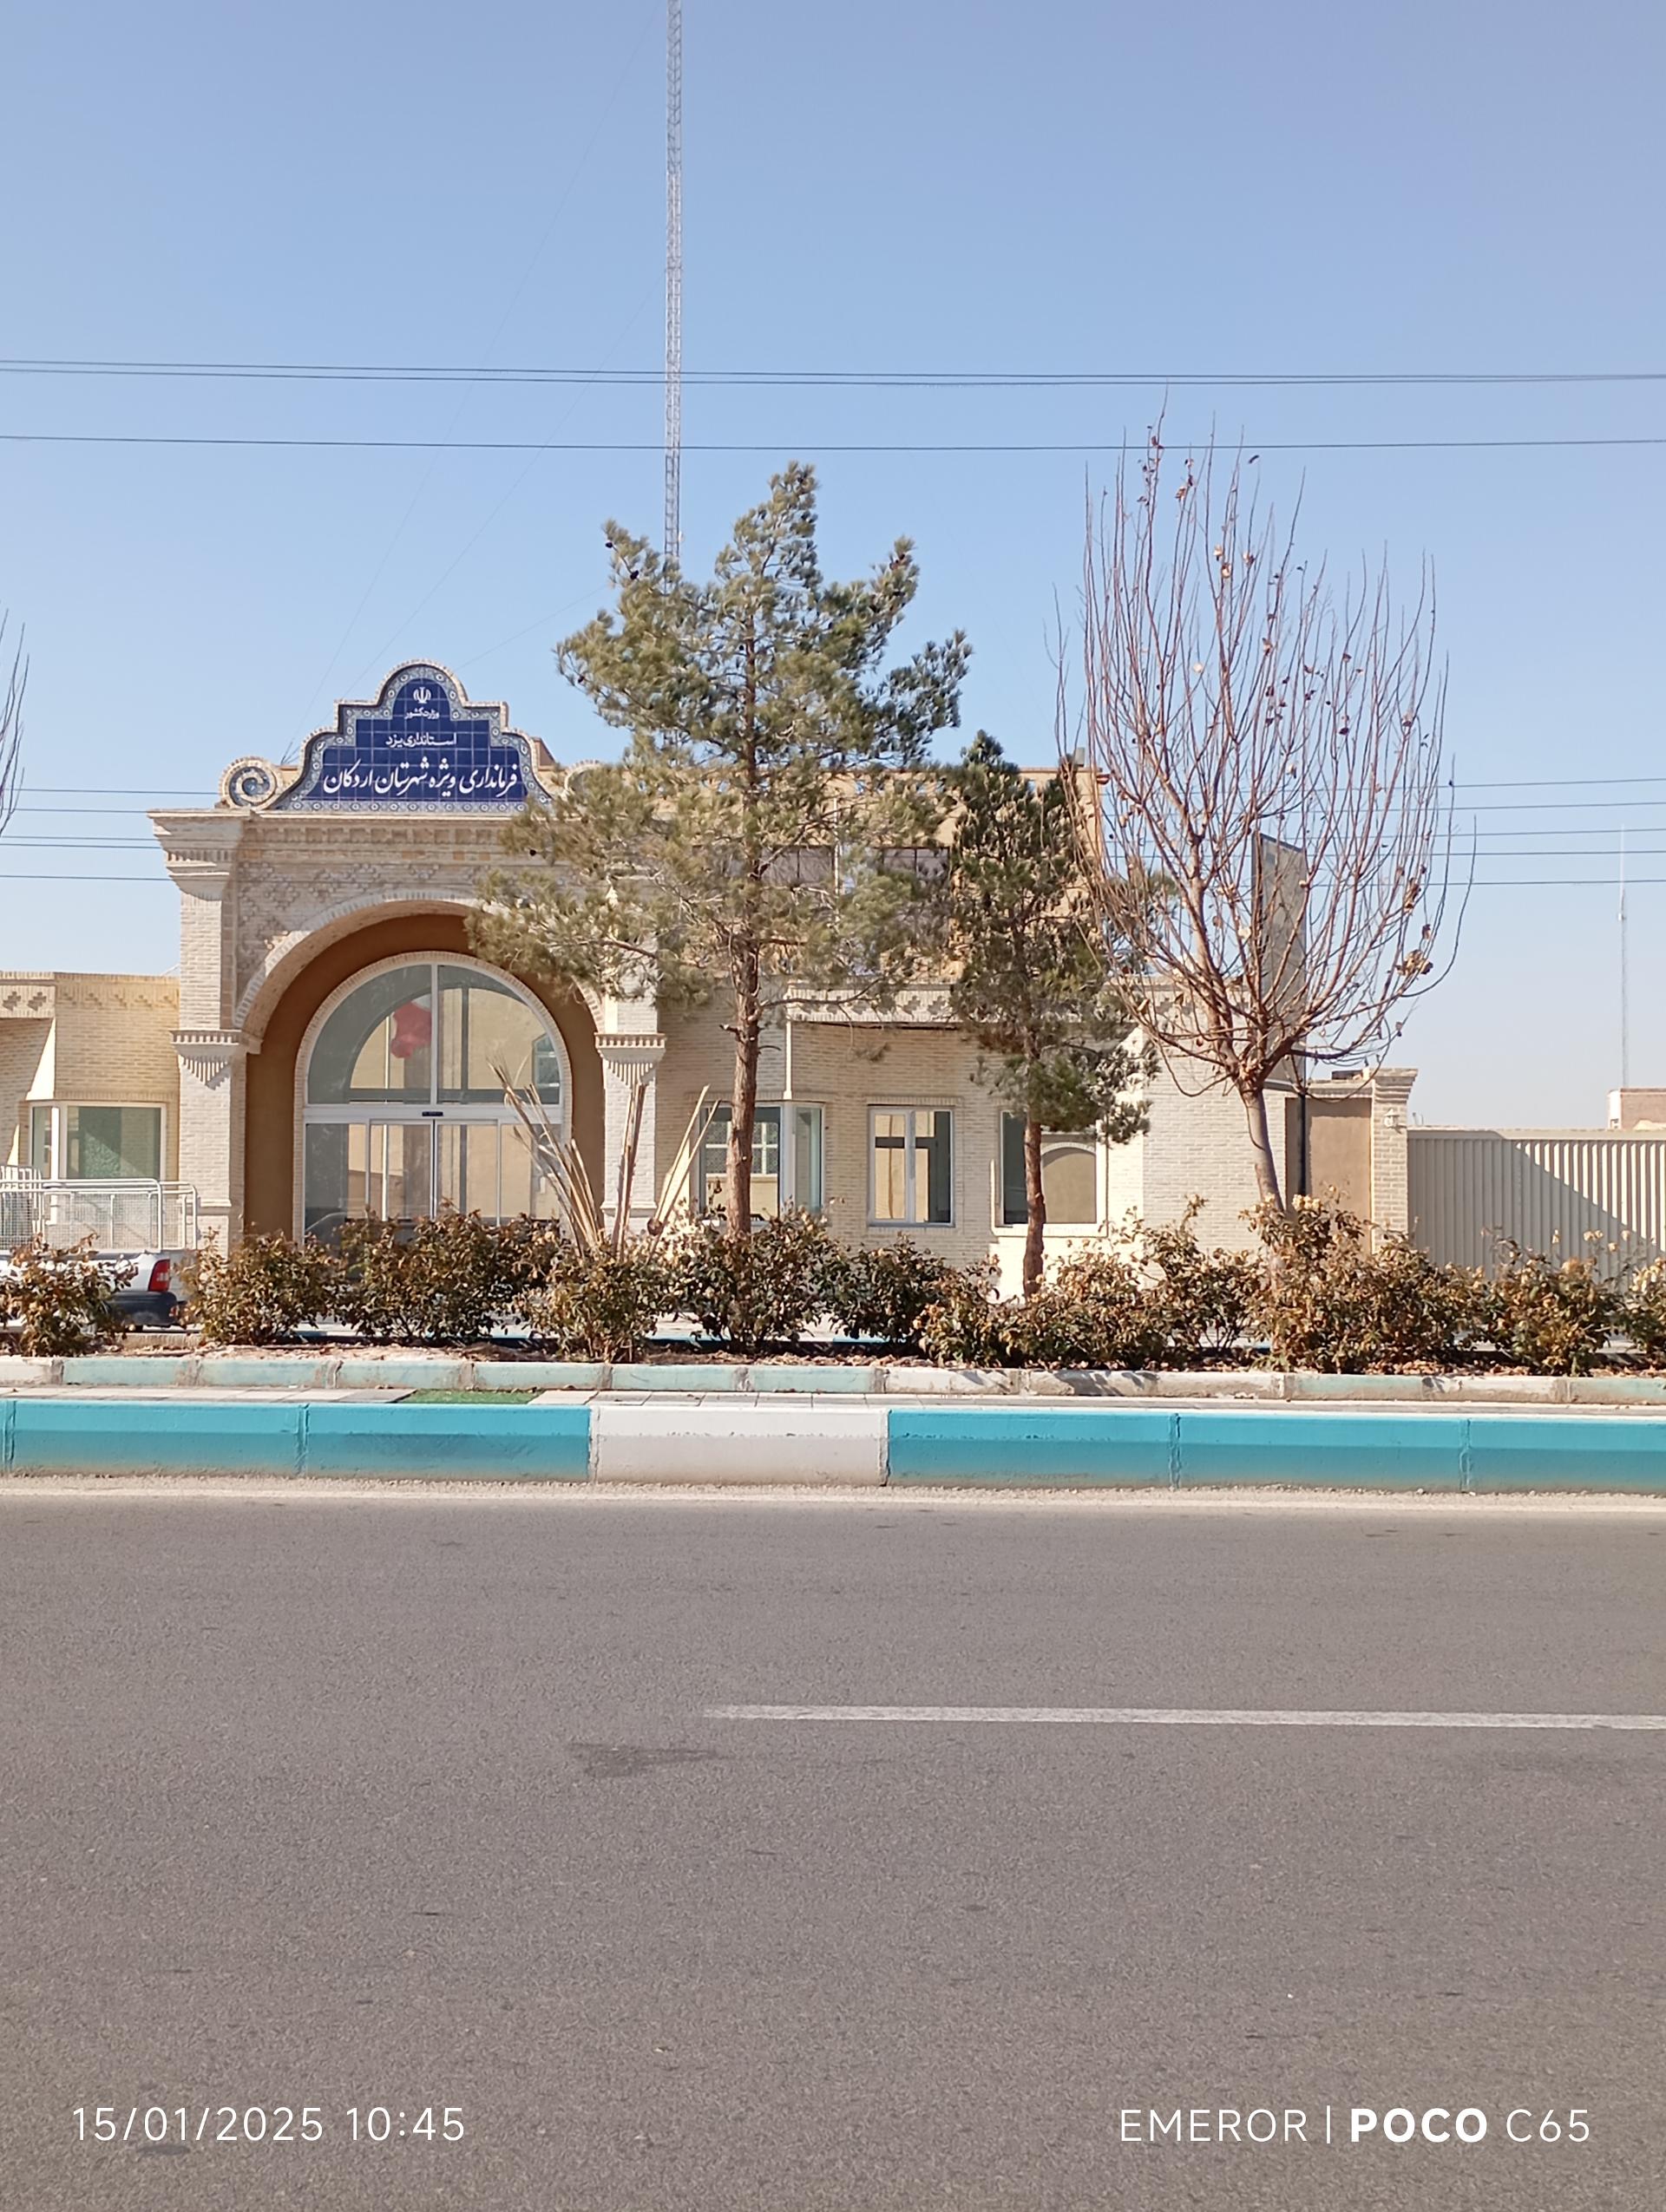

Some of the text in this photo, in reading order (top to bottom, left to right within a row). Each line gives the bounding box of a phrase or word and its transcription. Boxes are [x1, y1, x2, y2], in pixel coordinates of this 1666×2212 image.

[404, 707, 440, 719] وزارت کشور
[385, 731, 457, 748] استانداری یزد
[323, 756, 518, 797] فرمانداری ویژه شهرستان اردکان
